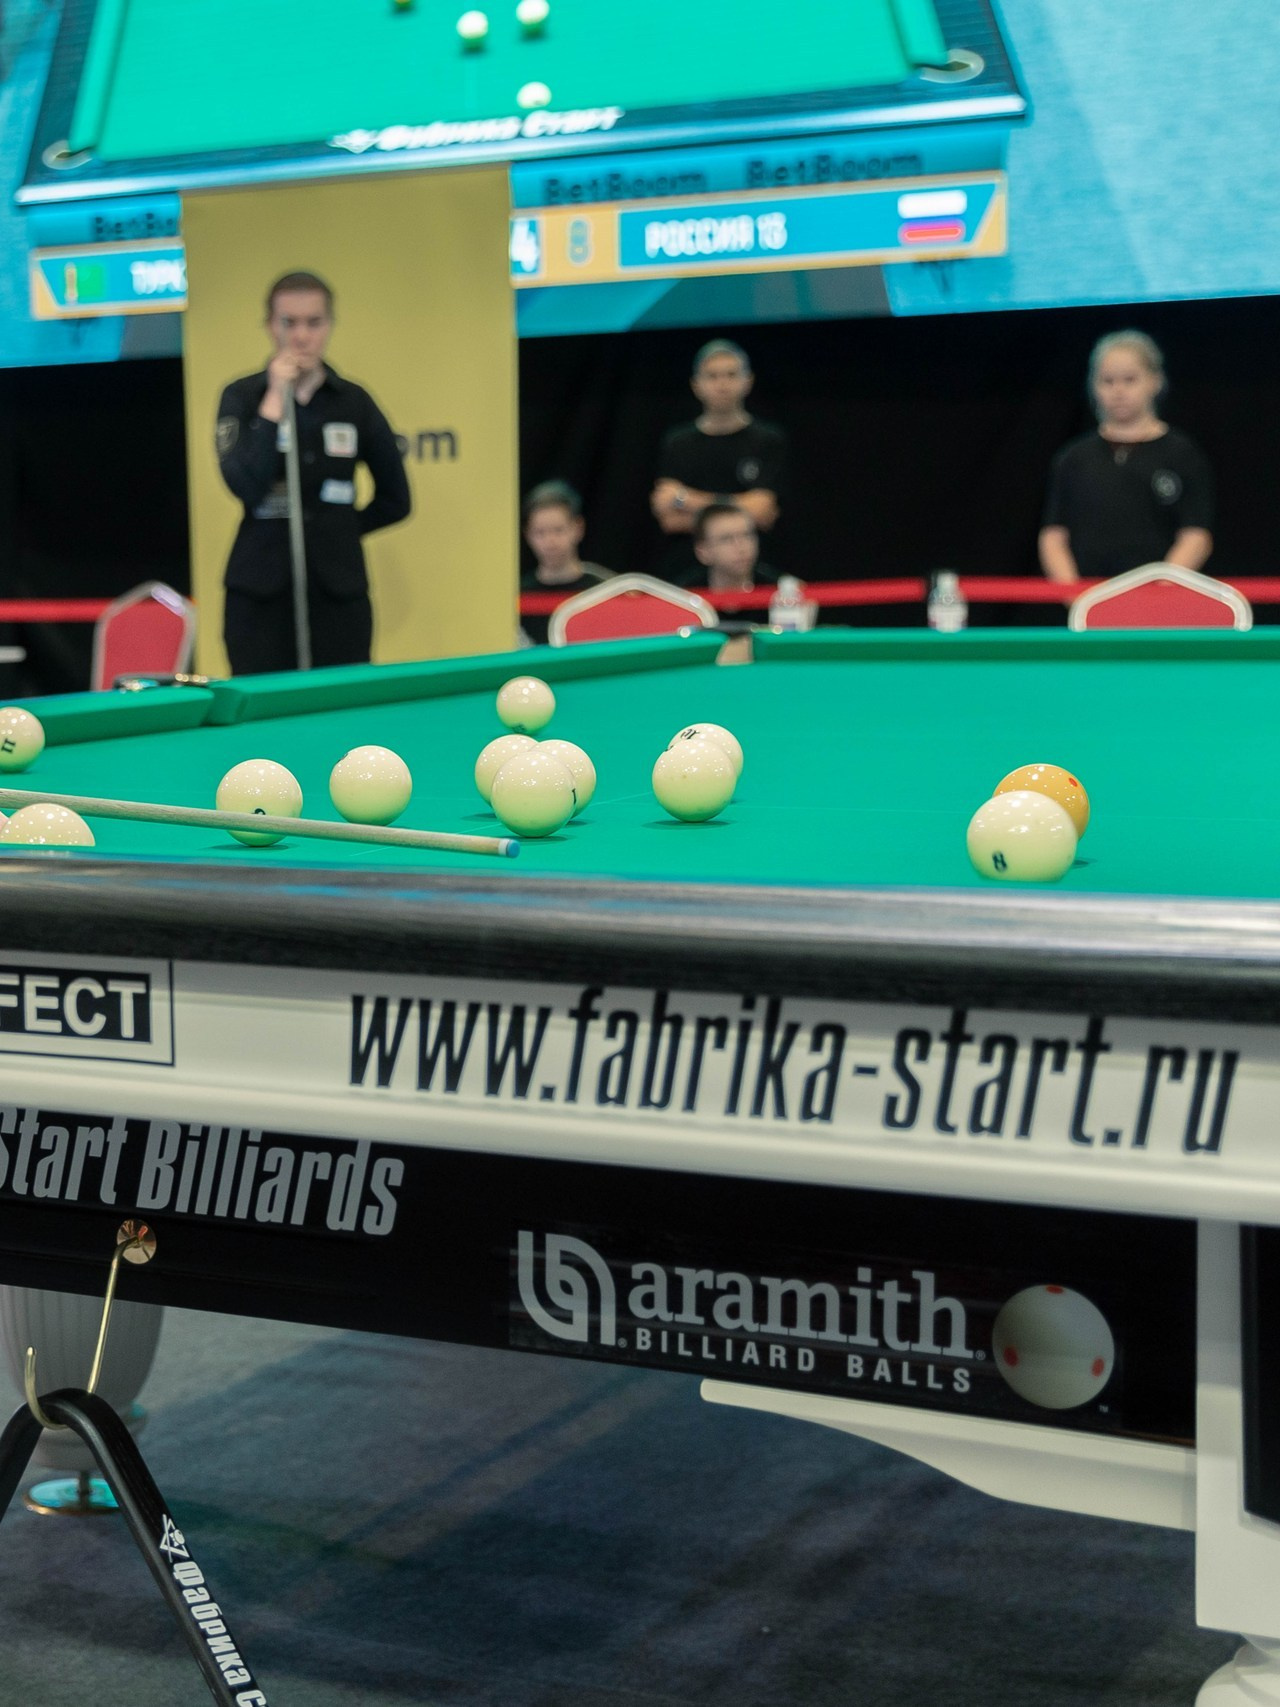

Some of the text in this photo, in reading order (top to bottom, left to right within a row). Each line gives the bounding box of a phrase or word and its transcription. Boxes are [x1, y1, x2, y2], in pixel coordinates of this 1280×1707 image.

[348, 985, 1241, 1156] www.fabrika-start.ru
[136, 1119, 406, 1236] Billiards
[628, 1262, 974, 1360] aramith
[637, 1328, 971, 1394] BILLIARD BALLS
[173, 1561, 251, 1686] Фабрика
